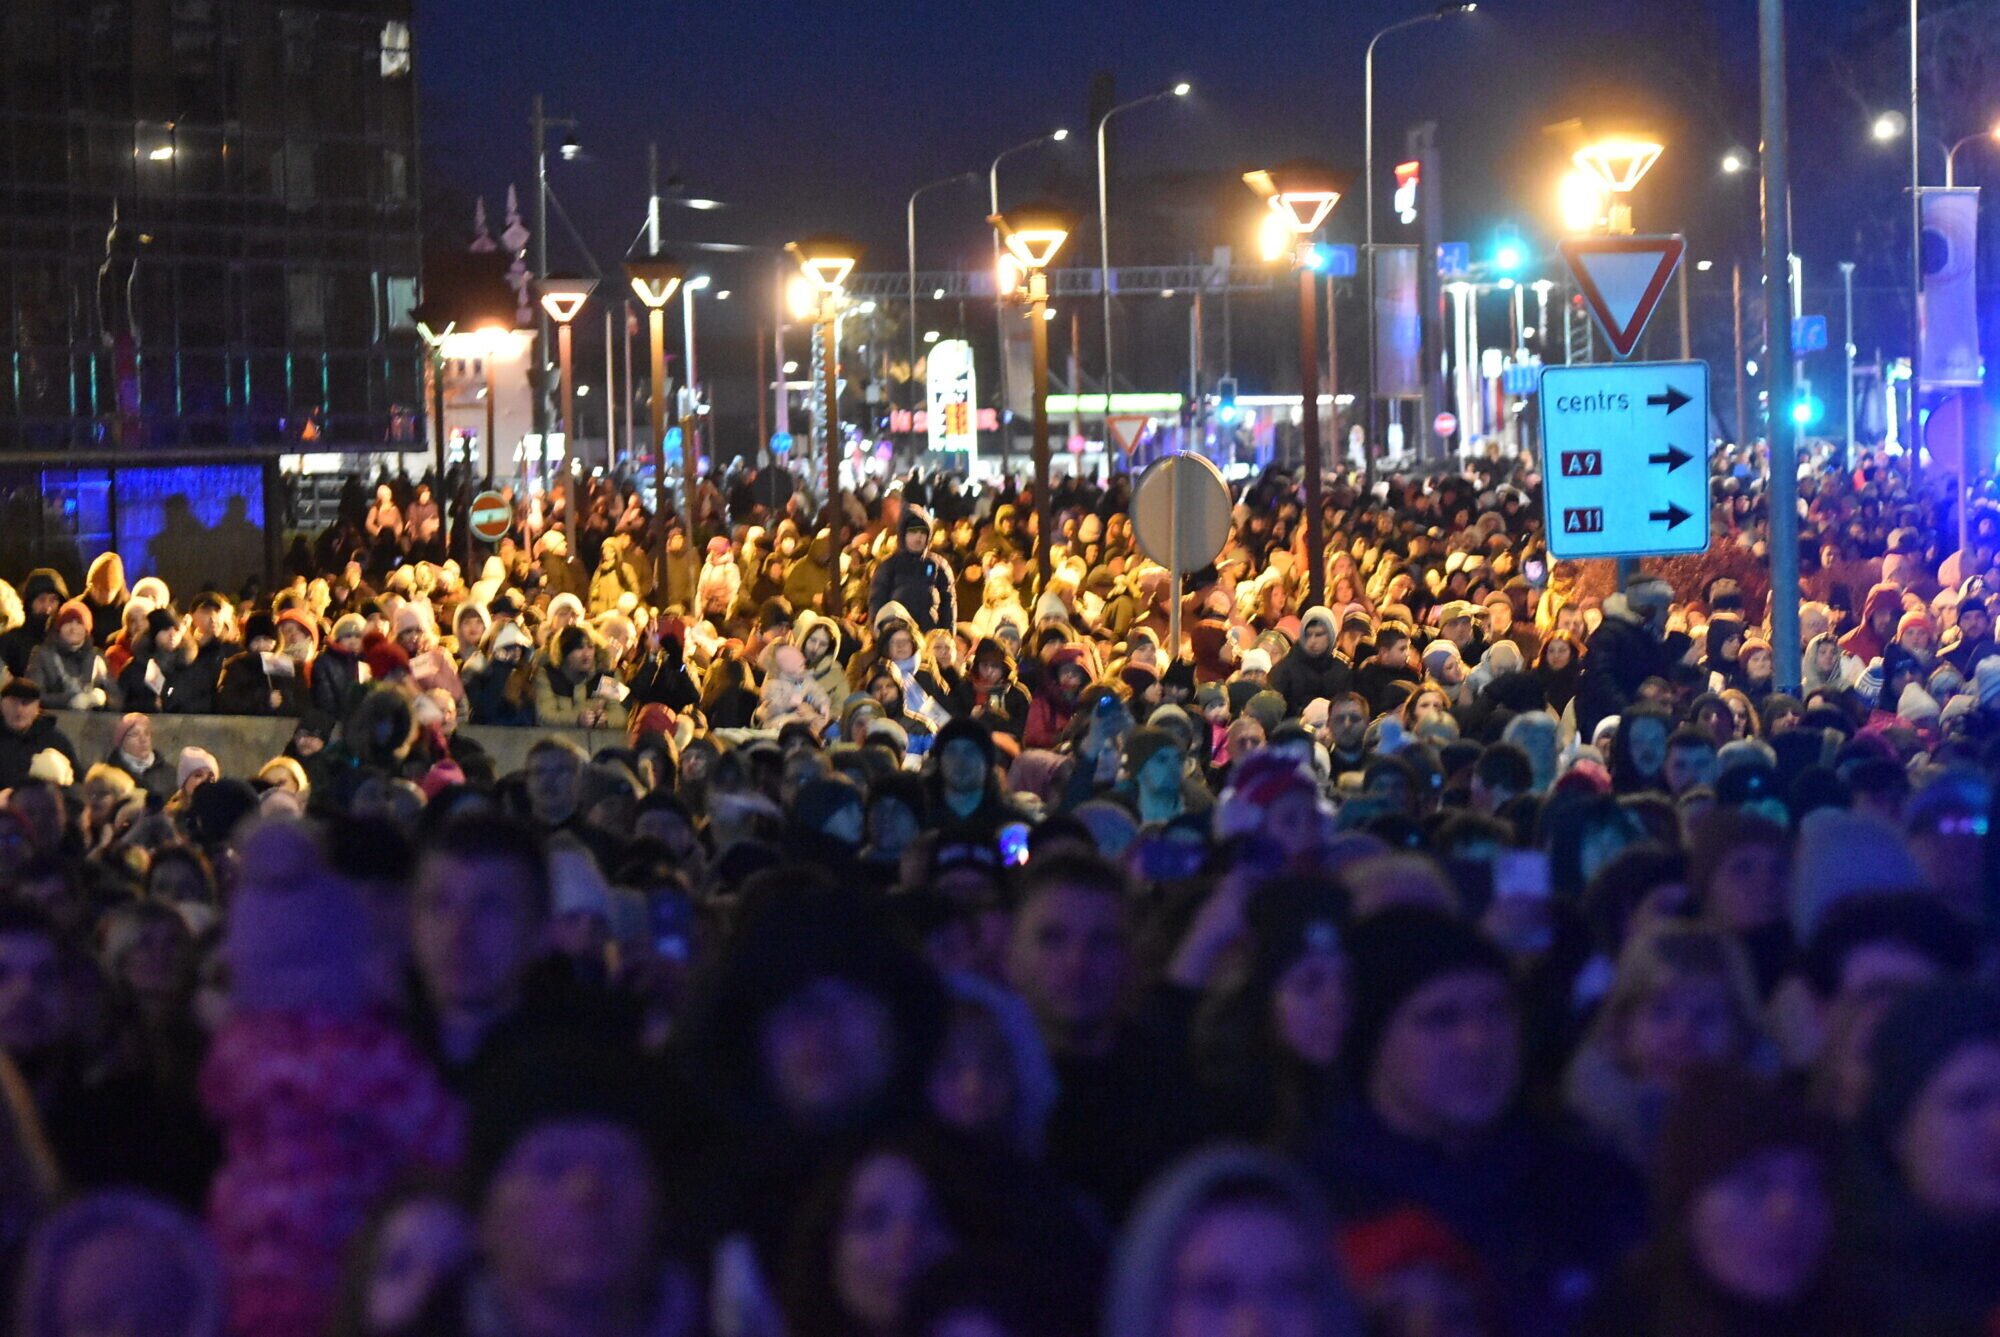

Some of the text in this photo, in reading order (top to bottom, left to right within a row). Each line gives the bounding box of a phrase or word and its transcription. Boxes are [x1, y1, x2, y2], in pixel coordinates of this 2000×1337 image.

[1557, 390, 1629, 412] centrs
[1568, 453, 1596, 474] A9
[1567, 510, 1601, 532] A11
